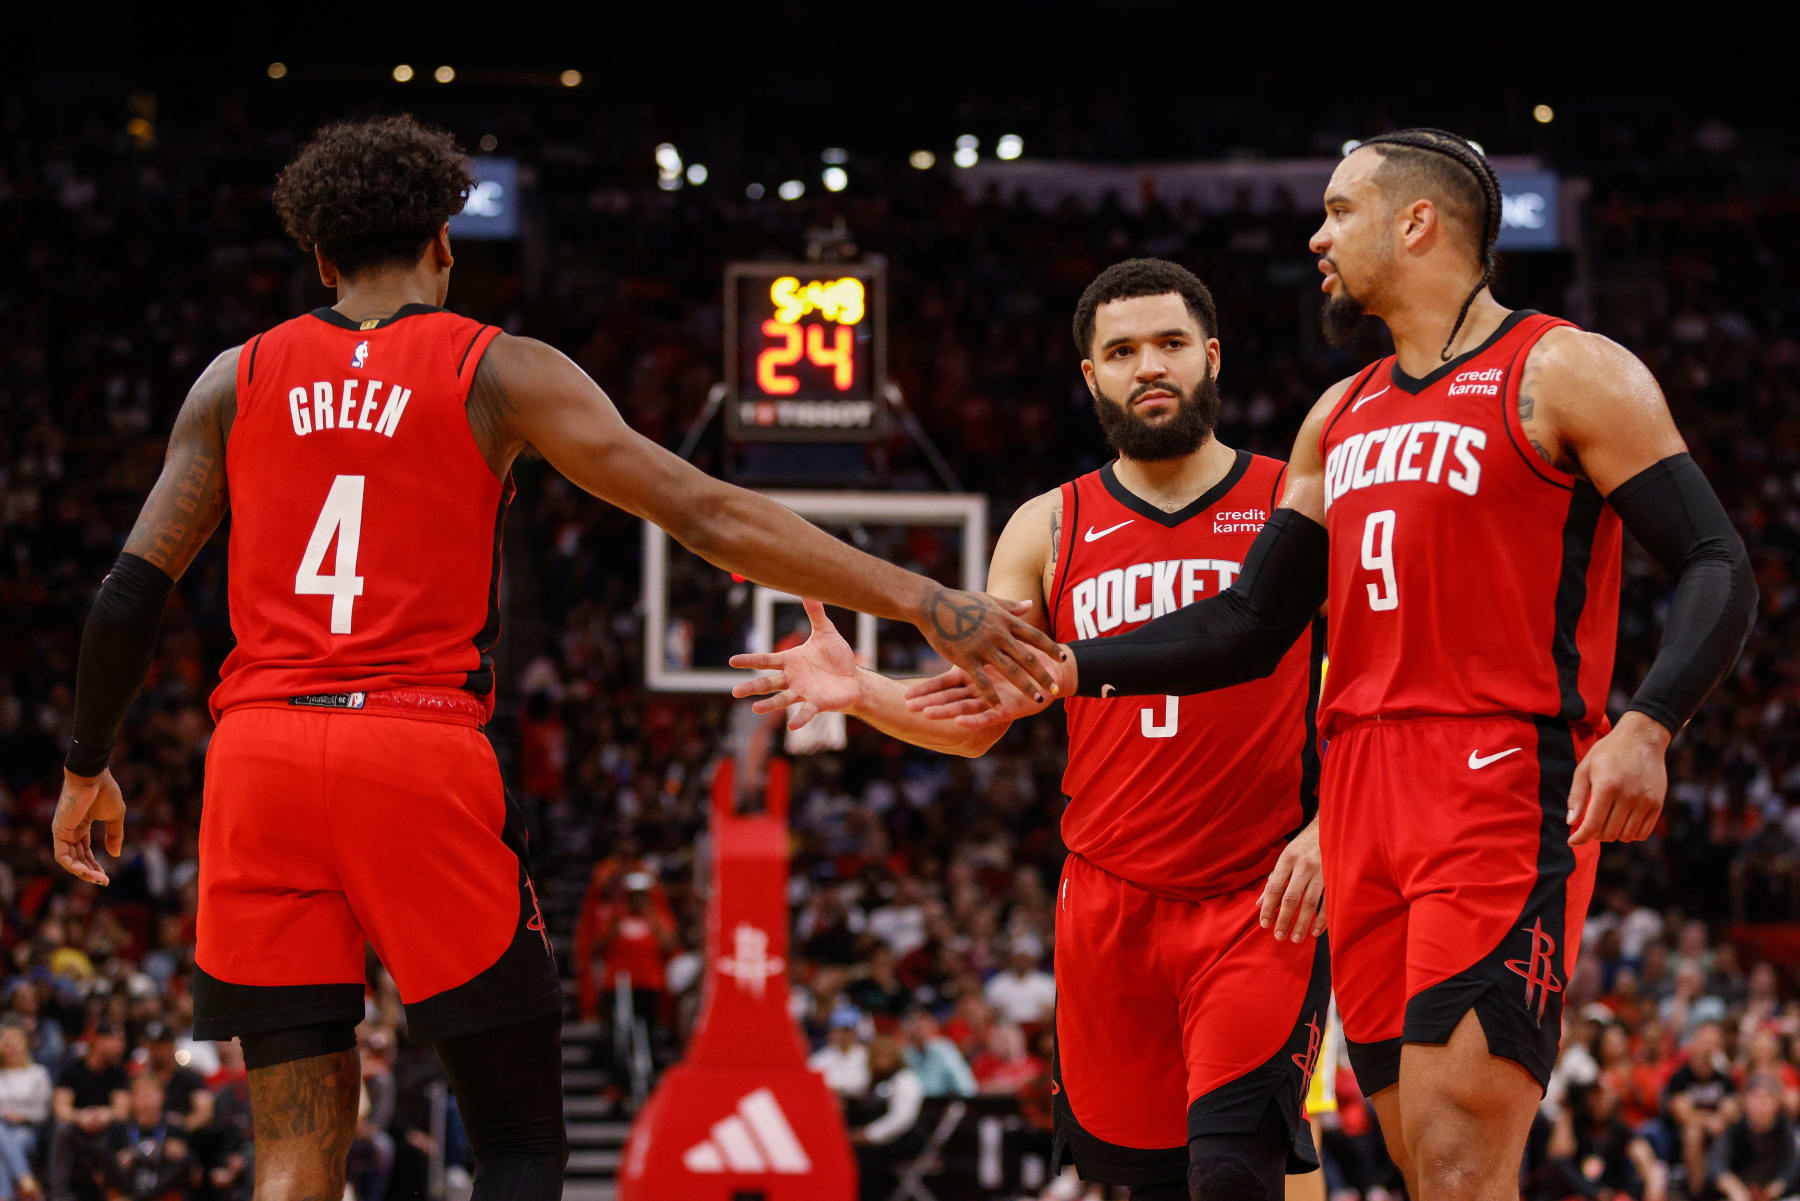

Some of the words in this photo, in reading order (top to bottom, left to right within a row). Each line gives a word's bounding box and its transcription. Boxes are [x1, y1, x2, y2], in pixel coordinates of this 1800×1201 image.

[757, 319, 853, 395] 24
[1447, 382, 1498, 397] karma
[1455, 368, 1503, 382] credit
[288, 379, 412, 438] GREEN
[1324, 420, 1487, 520] ROCKETS
[1213, 521, 1265, 534] karma
[1215, 508, 1266, 521] credit
[294, 474, 365, 635] 4
[1361, 509, 1399, 611] 9
[1071, 558, 1244, 641] ROCKET
